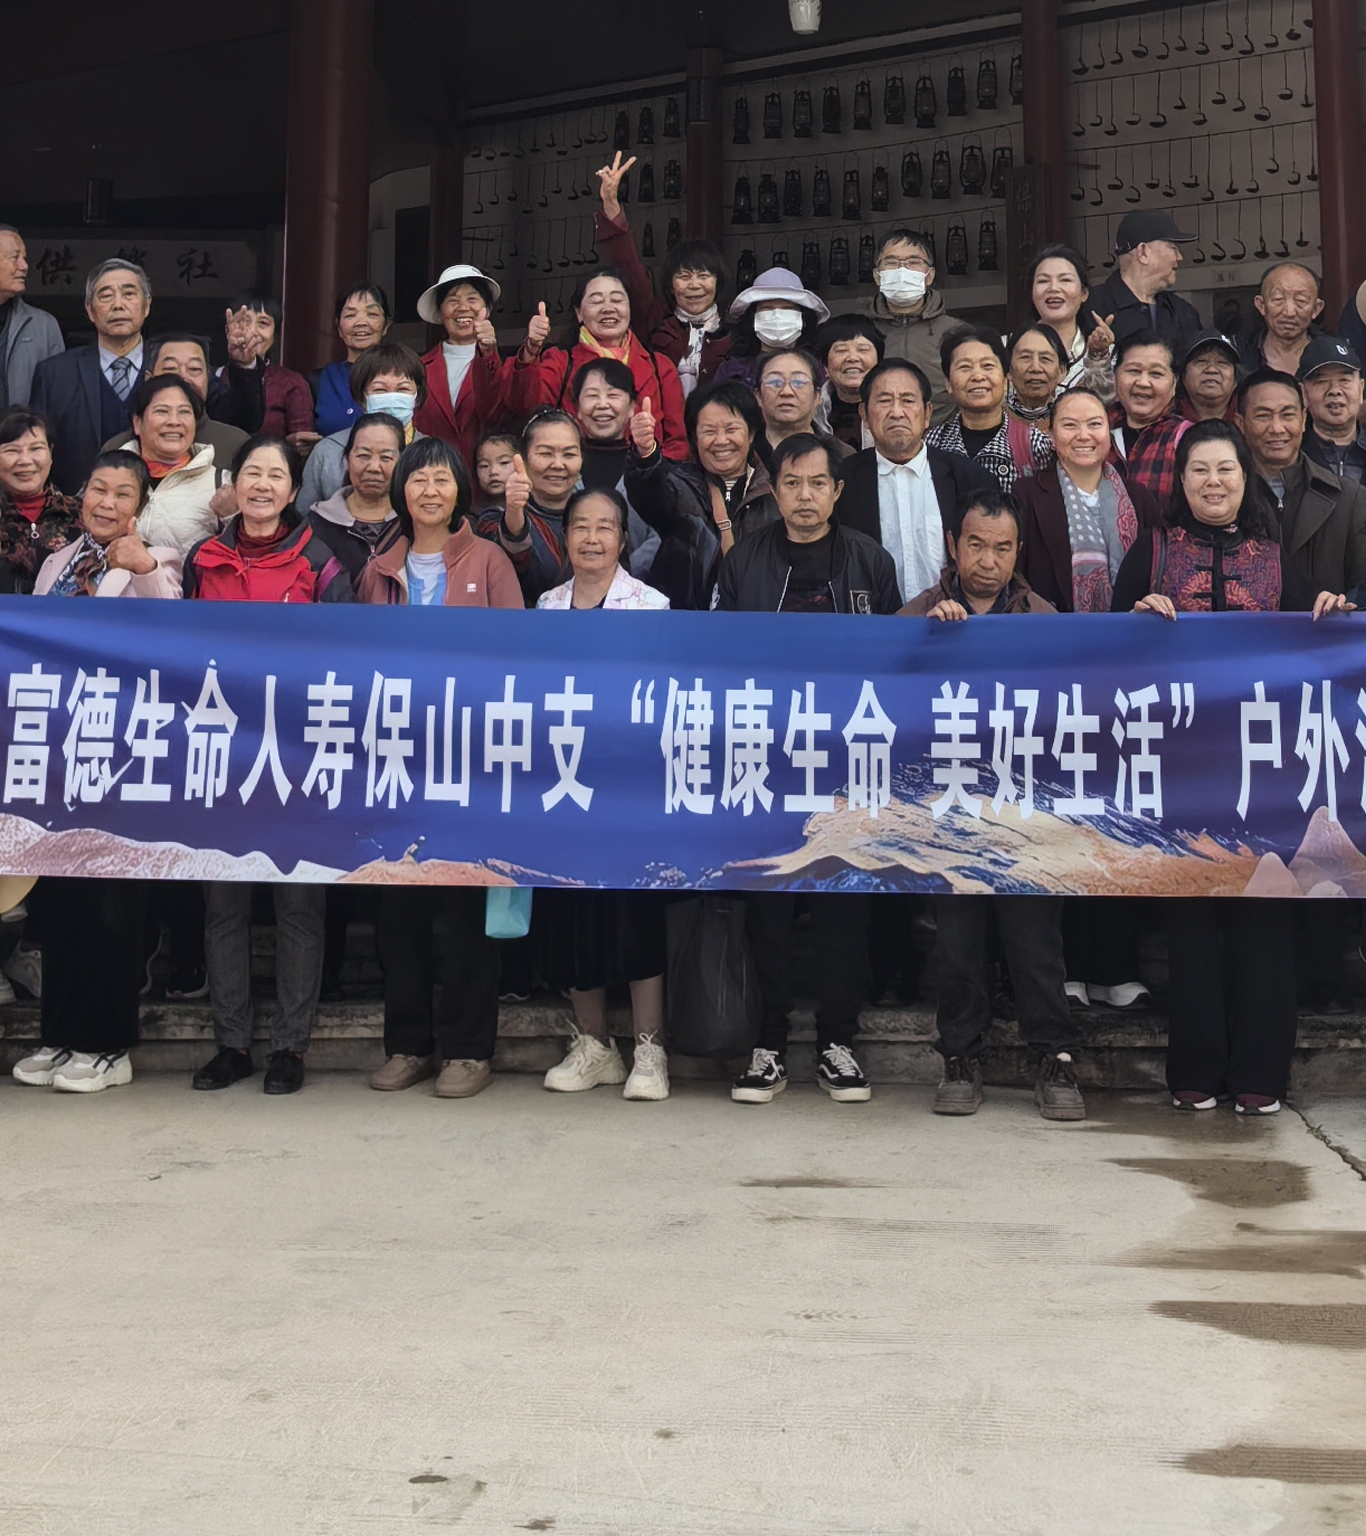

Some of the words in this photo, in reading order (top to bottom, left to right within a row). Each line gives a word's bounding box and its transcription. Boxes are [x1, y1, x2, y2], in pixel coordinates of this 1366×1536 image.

[2, 662, 595, 815] 富德生命人寿保山中支
